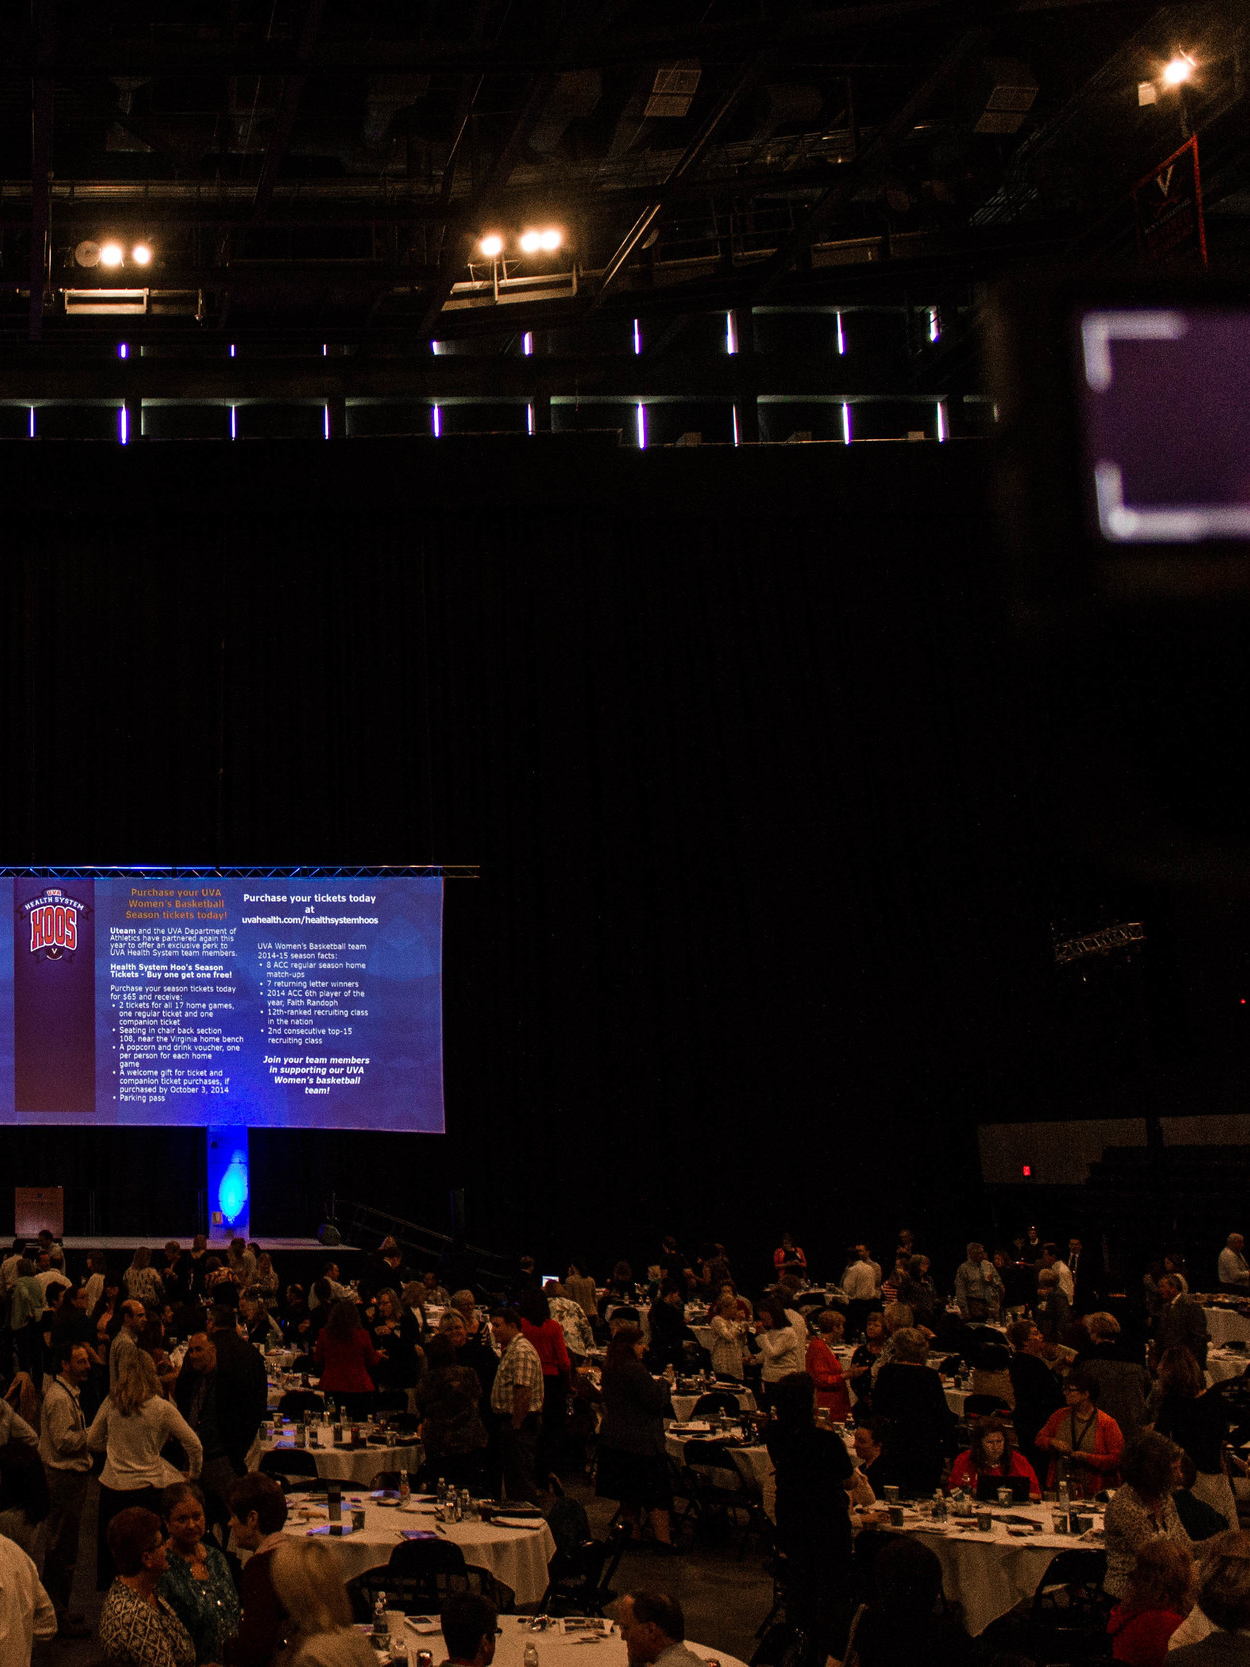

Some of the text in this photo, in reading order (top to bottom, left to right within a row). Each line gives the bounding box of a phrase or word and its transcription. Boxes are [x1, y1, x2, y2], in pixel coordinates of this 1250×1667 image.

[25, 896, 84, 910] HEALTH SYSTEM
[244, 894, 376, 904] Purchase your tickets today
[176, 900, 224, 908] Basketball
[197, 911, 227, 920] today!
[242, 916, 378, 925] uvahealth.com/healthsystemhoos
[31, 906, 77, 951] HOOS
[153, 949, 179, 957] System
[147, 971, 161, 979] Buy
[182, 971, 194, 979] get
[267, 971, 305, 979] match-ups
[274, 980, 307, 988] returning
[216, 985, 236, 993] today
[314, 1009, 348, 1017] recruiting
[119, 1027, 146, 1035] Seating
[280, 1066, 326, 1075] supporting
[316, 1076, 360, 1084] basketball
[120, 1086, 156, 1094] purchased
[159, 1086, 167, 1094] by
[120, 1095, 146, 1103] Parking
